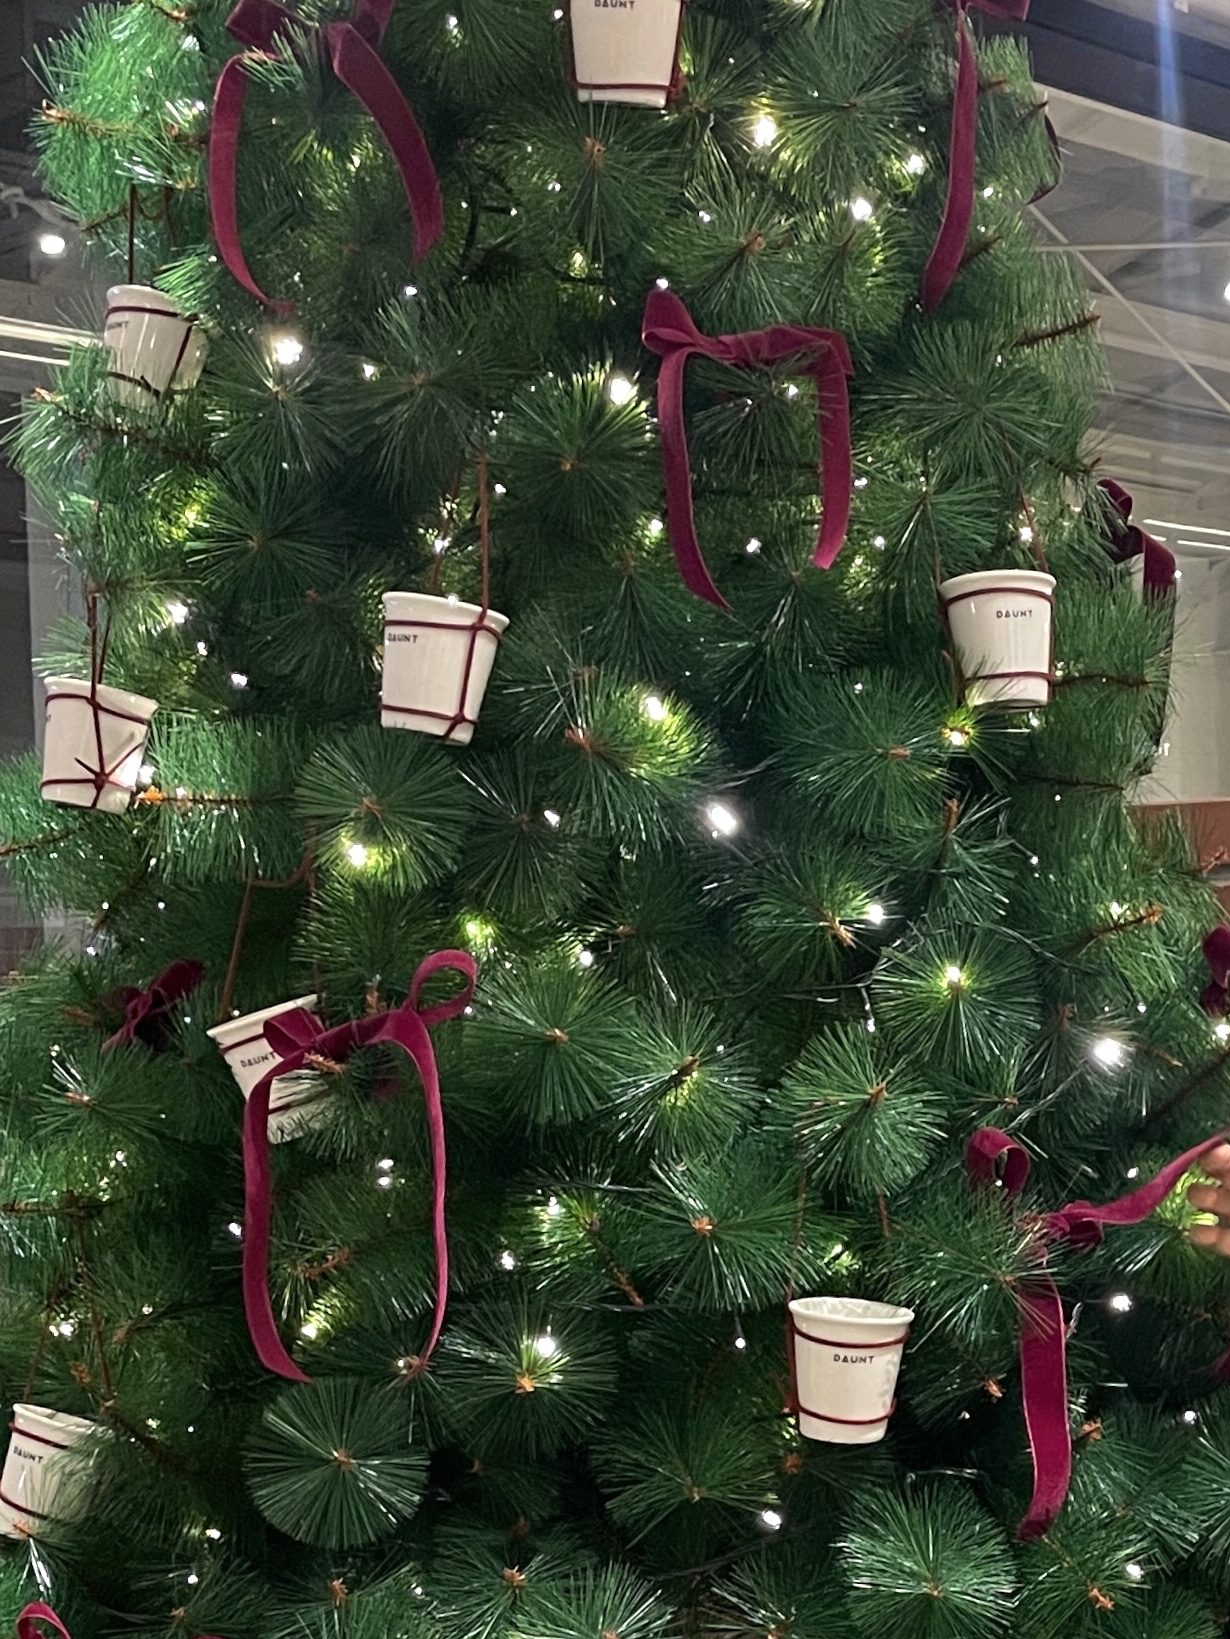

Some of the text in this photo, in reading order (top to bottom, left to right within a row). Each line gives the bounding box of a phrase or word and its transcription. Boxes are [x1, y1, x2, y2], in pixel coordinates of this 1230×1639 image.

[594, 0, 635, 10] DAUNT
[995, 609, 1033, 619] DAUNT
[240, 1051, 276, 1068] DAUNT
[833, 1353, 876, 1364] DAUNT
[13, 1446, 44, 1463] DAUNT
